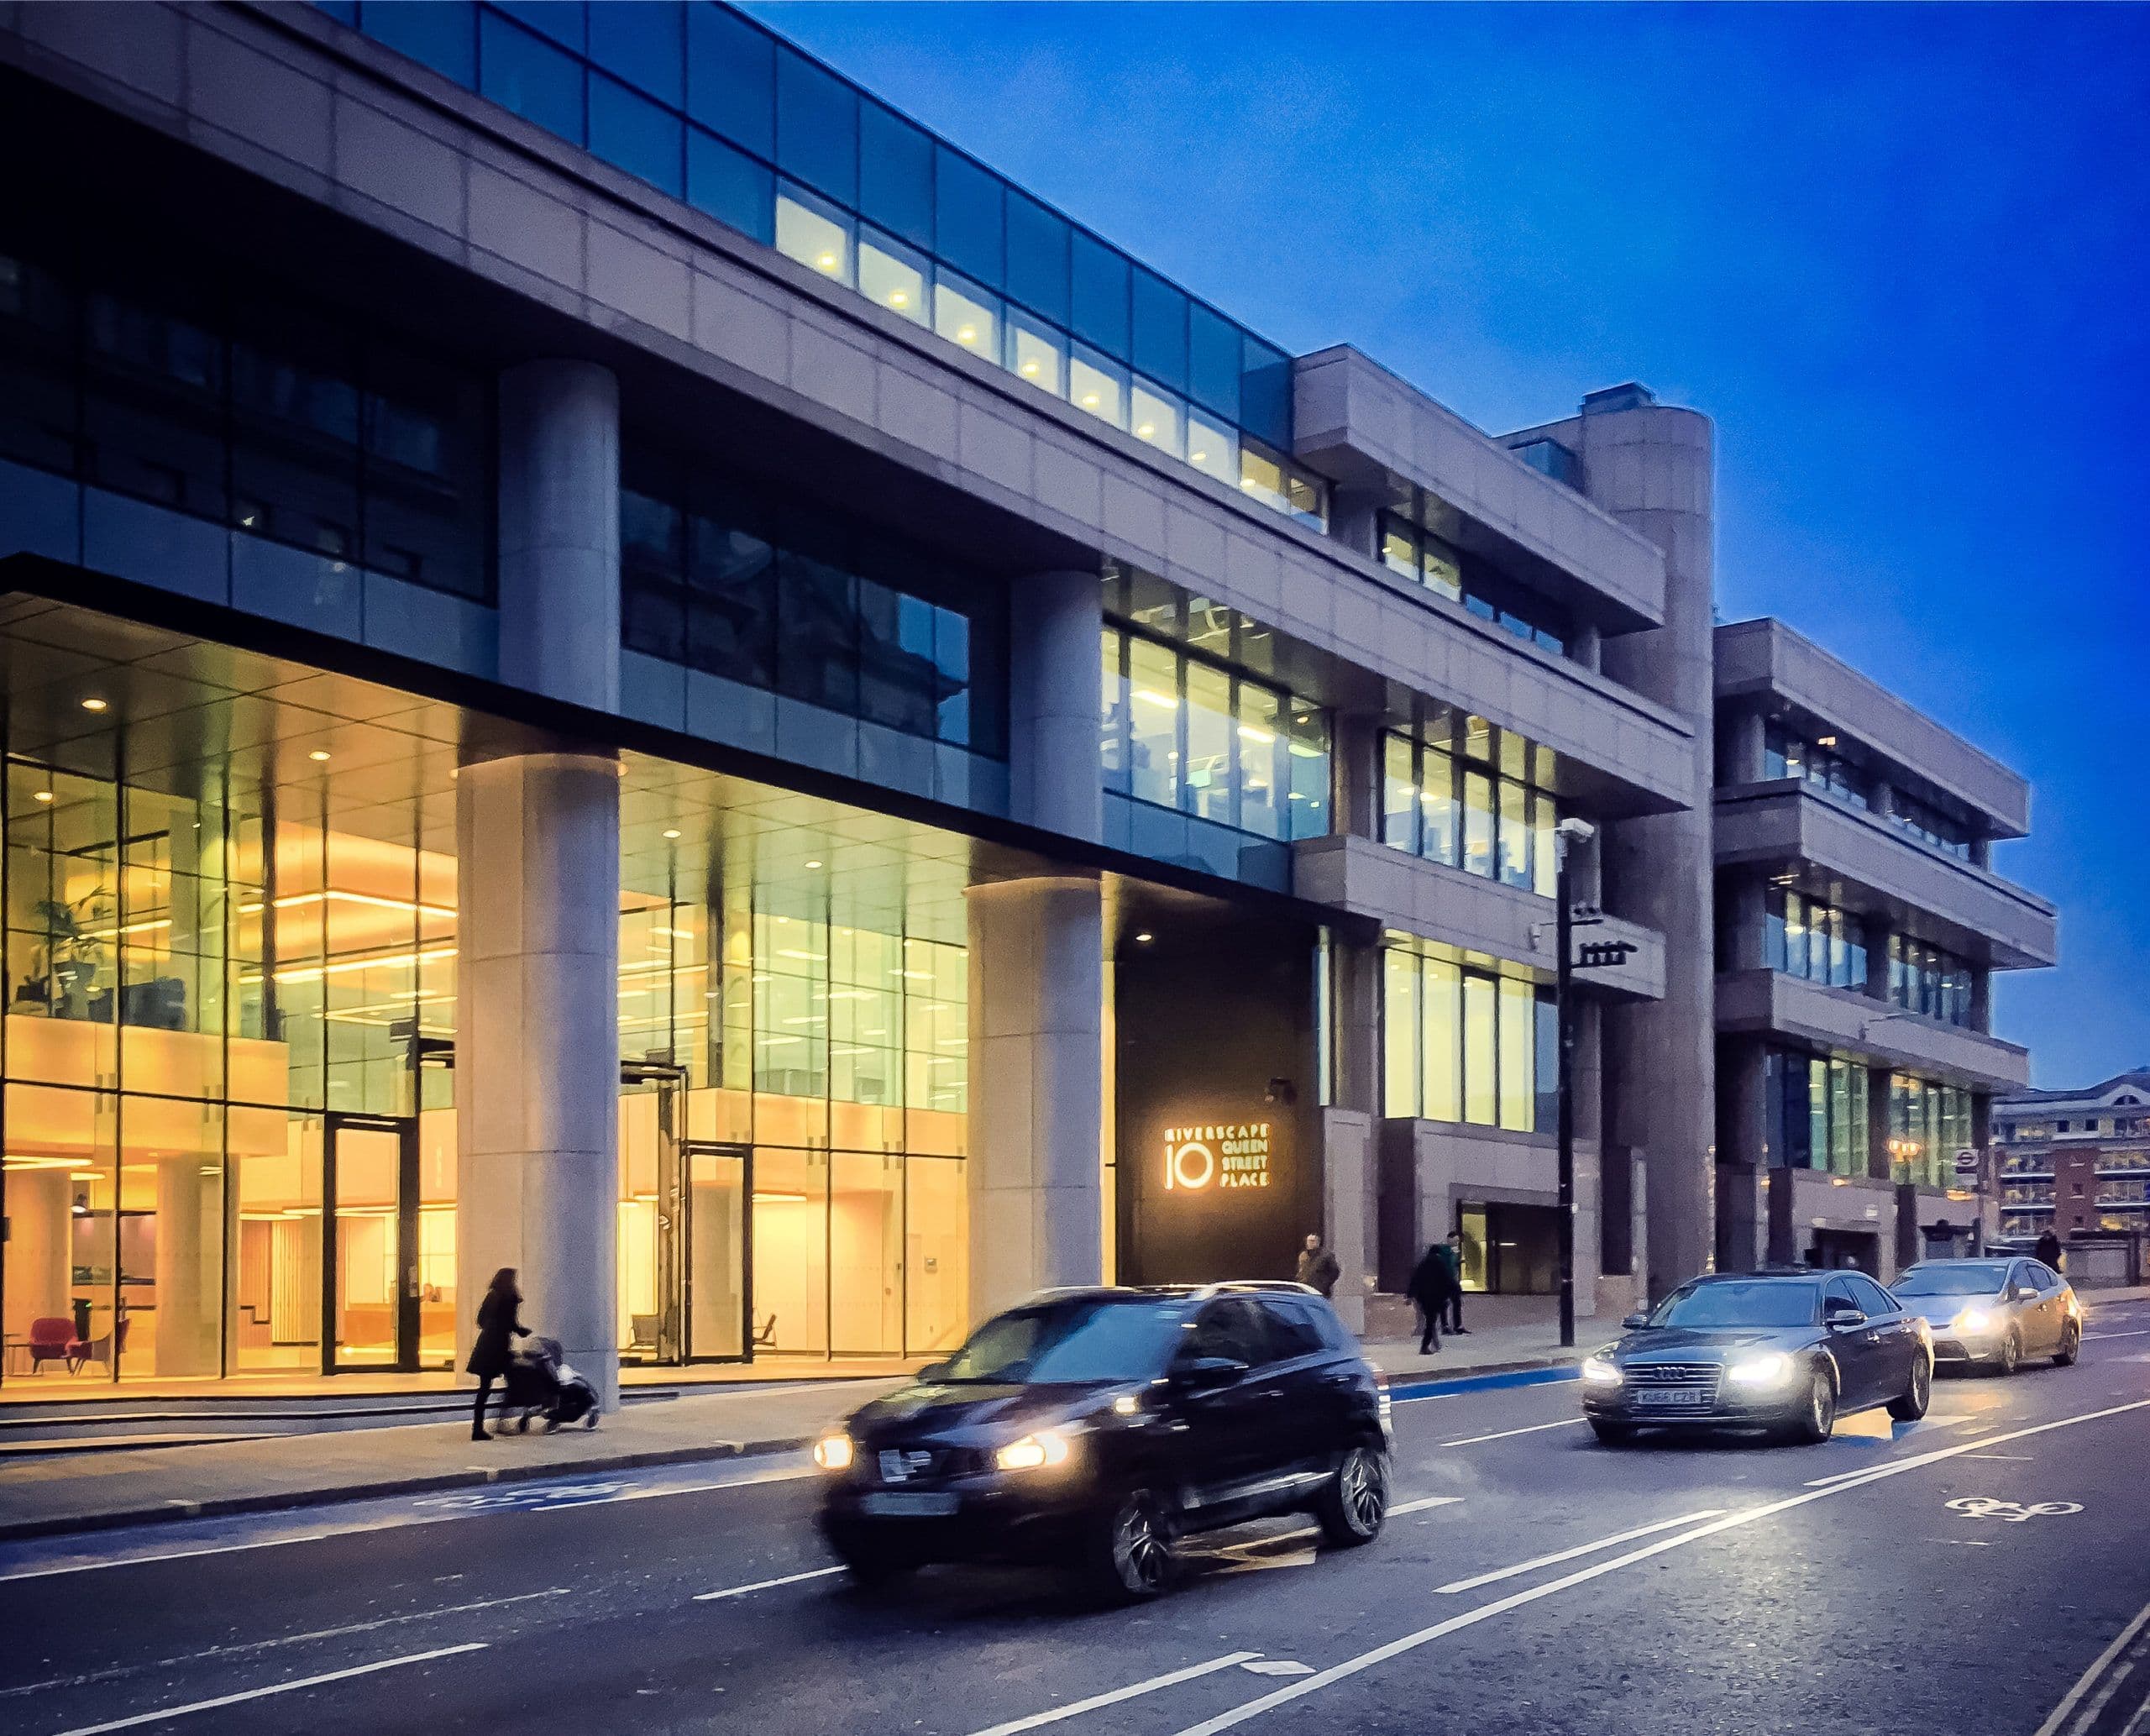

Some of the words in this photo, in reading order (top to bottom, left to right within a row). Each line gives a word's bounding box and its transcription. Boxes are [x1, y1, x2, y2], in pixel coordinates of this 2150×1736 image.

[1165, 1124, 1269, 1141] RIVERSCAPE
[1222, 1140, 1268, 1154] QUEEN
[1165, 1142, 1214, 1189] 10
[1222, 1156, 1267, 1170] STREET
[1220, 1172, 1269, 1188] PLACE
